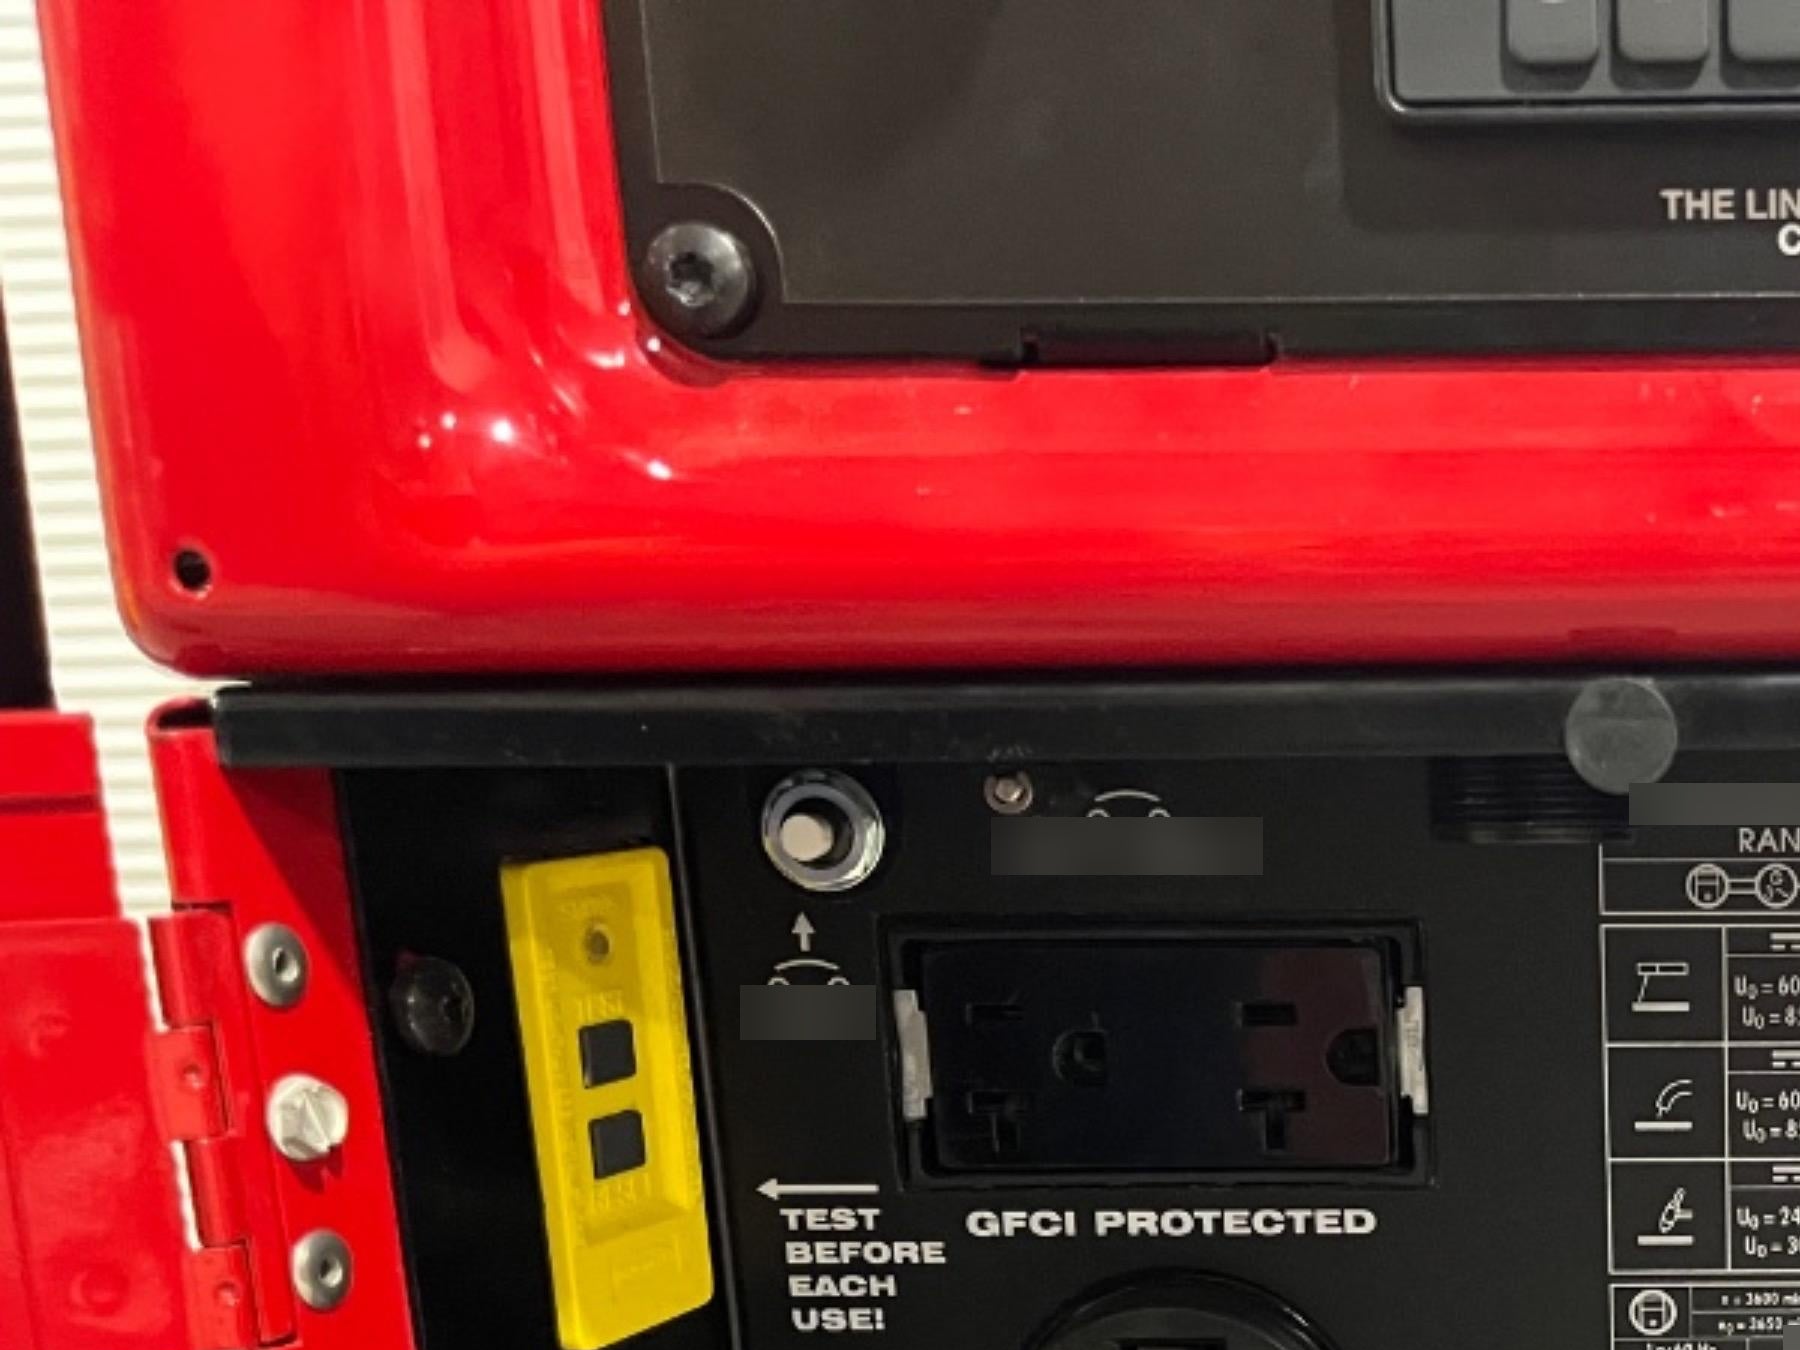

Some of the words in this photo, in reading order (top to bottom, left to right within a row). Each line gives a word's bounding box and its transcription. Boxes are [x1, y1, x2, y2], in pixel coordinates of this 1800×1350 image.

[1660, 188, 1735, 220] THE
[779, 1207, 882, 1232] TEST
[965, 1210, 1077, 1237] GFCI
[1095, 1208, 1378, 1237] PROTECTED
[784, 1240, 946, 1265] BEFORE
[788, 1274, 897, 1298] EACH
[792, 1307, 885, 1332] USE!
